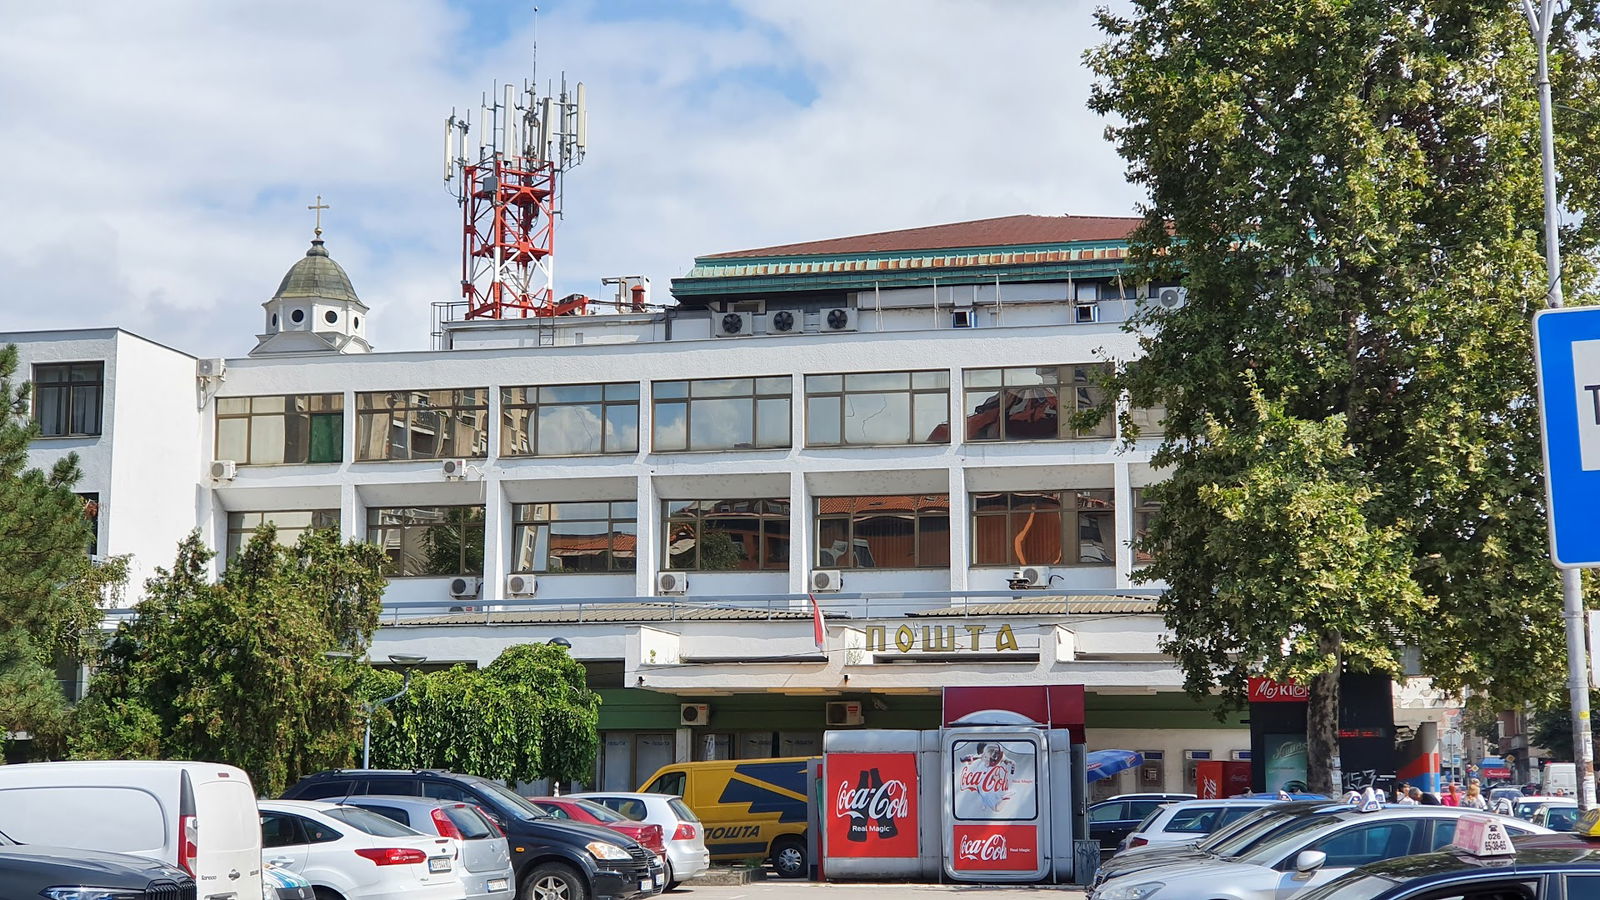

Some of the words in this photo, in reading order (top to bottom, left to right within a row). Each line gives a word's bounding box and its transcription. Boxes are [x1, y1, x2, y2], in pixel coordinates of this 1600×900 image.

[866, 624, 1018, 653] ПОШТА
[1255, 680, 1278, 698] Moj
[960, 766, 1009, 792] Coca-Cola
[836, 780, 908, 819] Coca-Cola
[869, 825, 890, 833] Magic
[960, 834, 1007, 861] Coca-Cola
